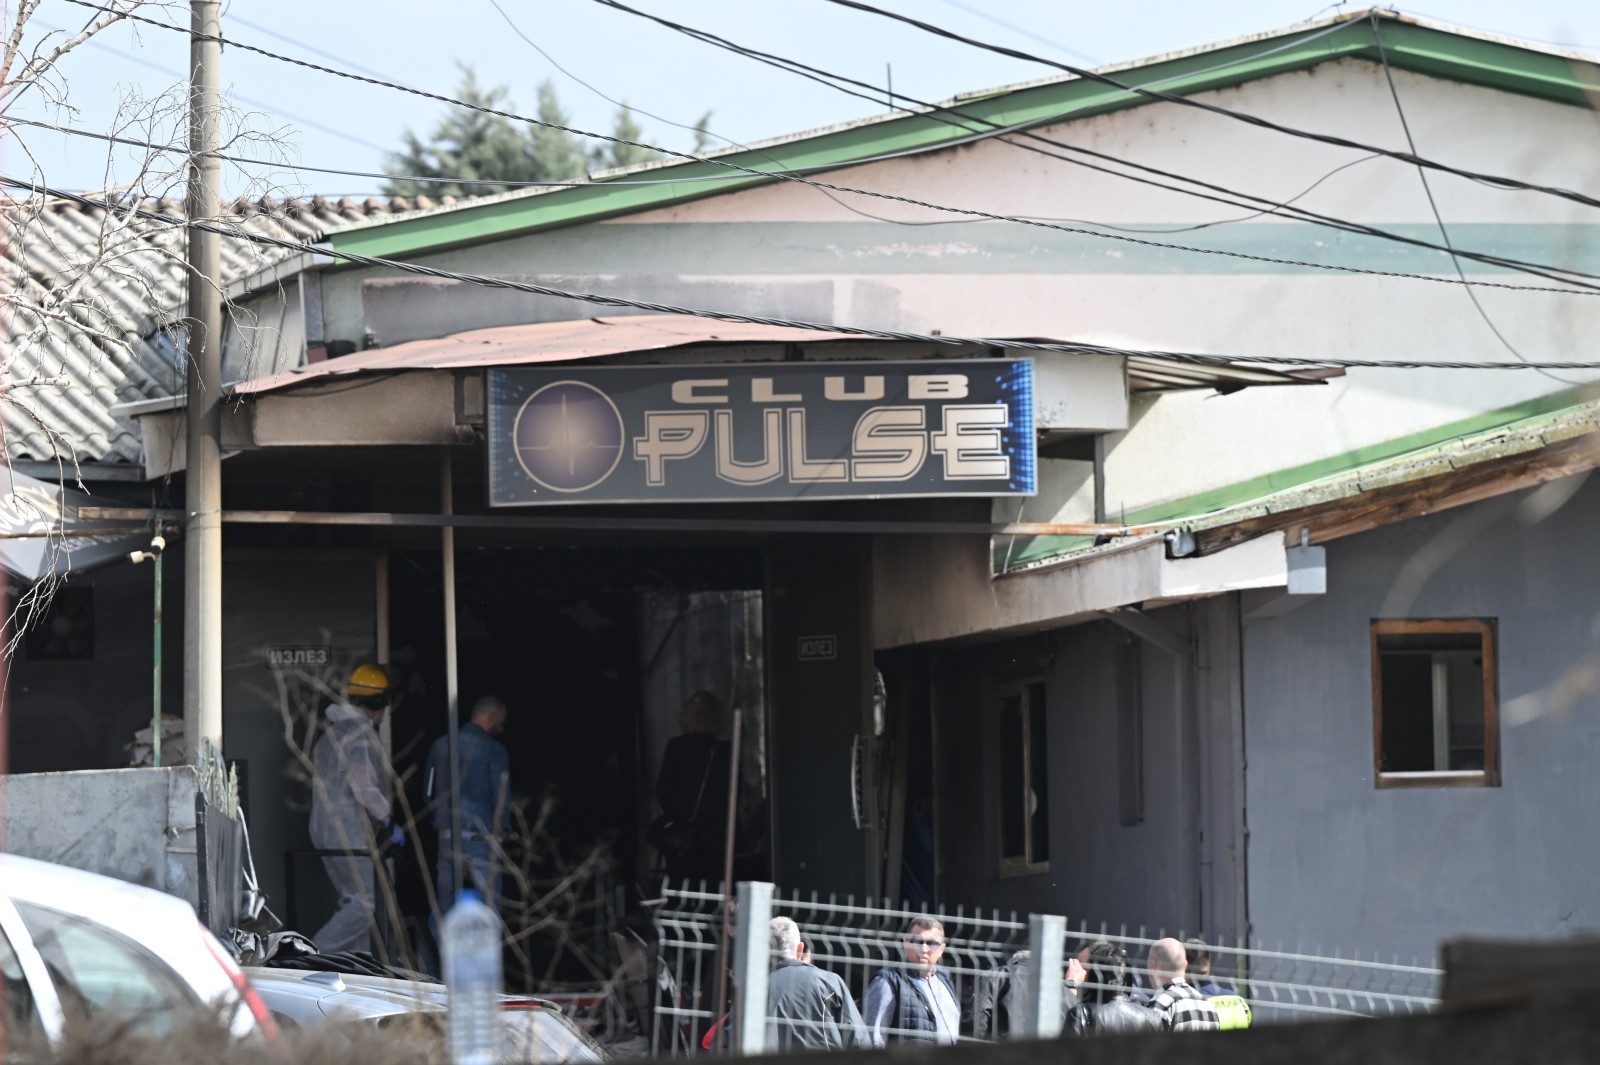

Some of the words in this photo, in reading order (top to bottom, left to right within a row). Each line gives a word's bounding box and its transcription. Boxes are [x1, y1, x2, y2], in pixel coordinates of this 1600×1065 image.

[672, 374, 969, 404] CLUB
[633, 403, 1010, 487] PULSE
[270, 649, 327, 664] ИЗЛЕЗ
